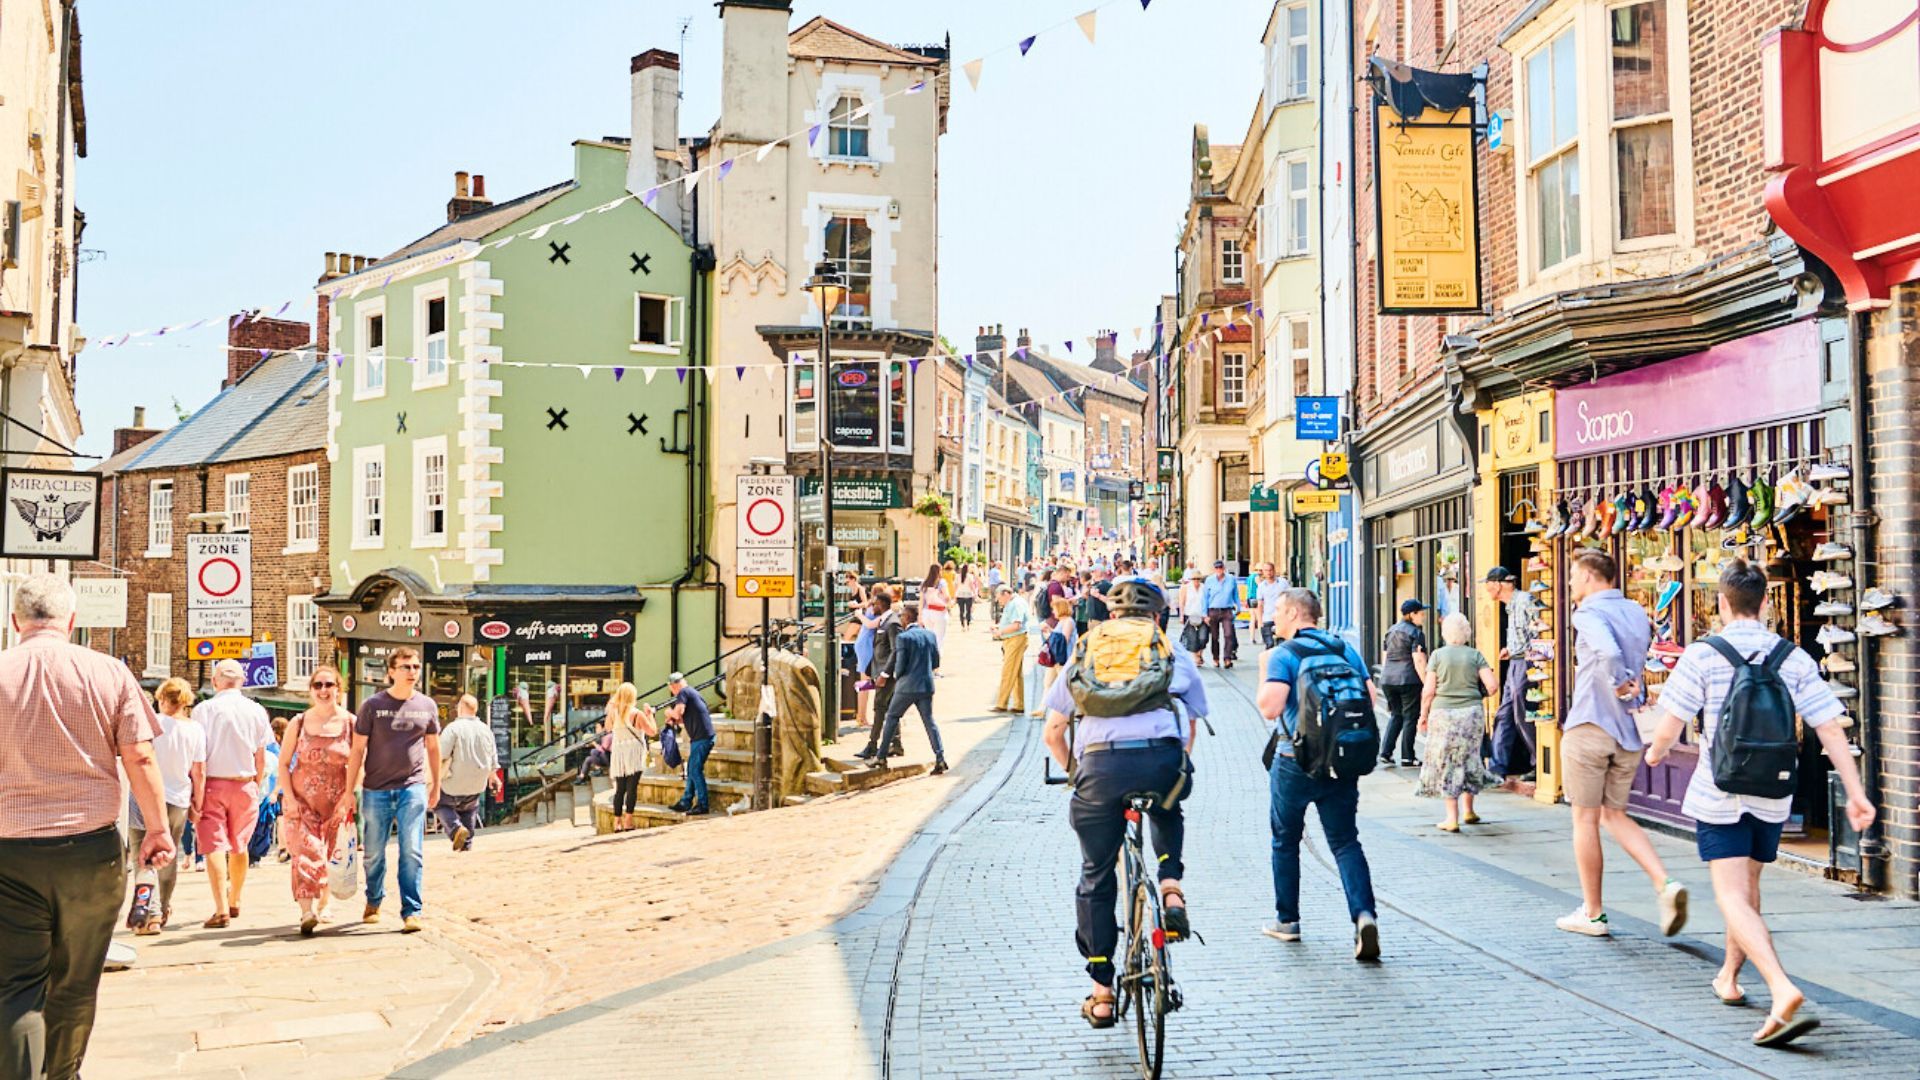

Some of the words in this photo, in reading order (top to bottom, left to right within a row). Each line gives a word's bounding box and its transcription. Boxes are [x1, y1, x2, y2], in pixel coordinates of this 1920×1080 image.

[1386, 143, 1435, 155] Vennels
[1576, 400, 1633, 444] Scorpio
[11, 478, 92, 492] MIRACLES
[747, 486, 783, 496] ZONE
[817, 485, 884, 500] Qickstitch
[816, 527, 879, 541] Qickstitch
[198, 544, 240, 555] ZONE
[204, 619, 235, 627] loading
[547, 623, 598, 637] capriccio
[525, 650, 551, 663] panini
